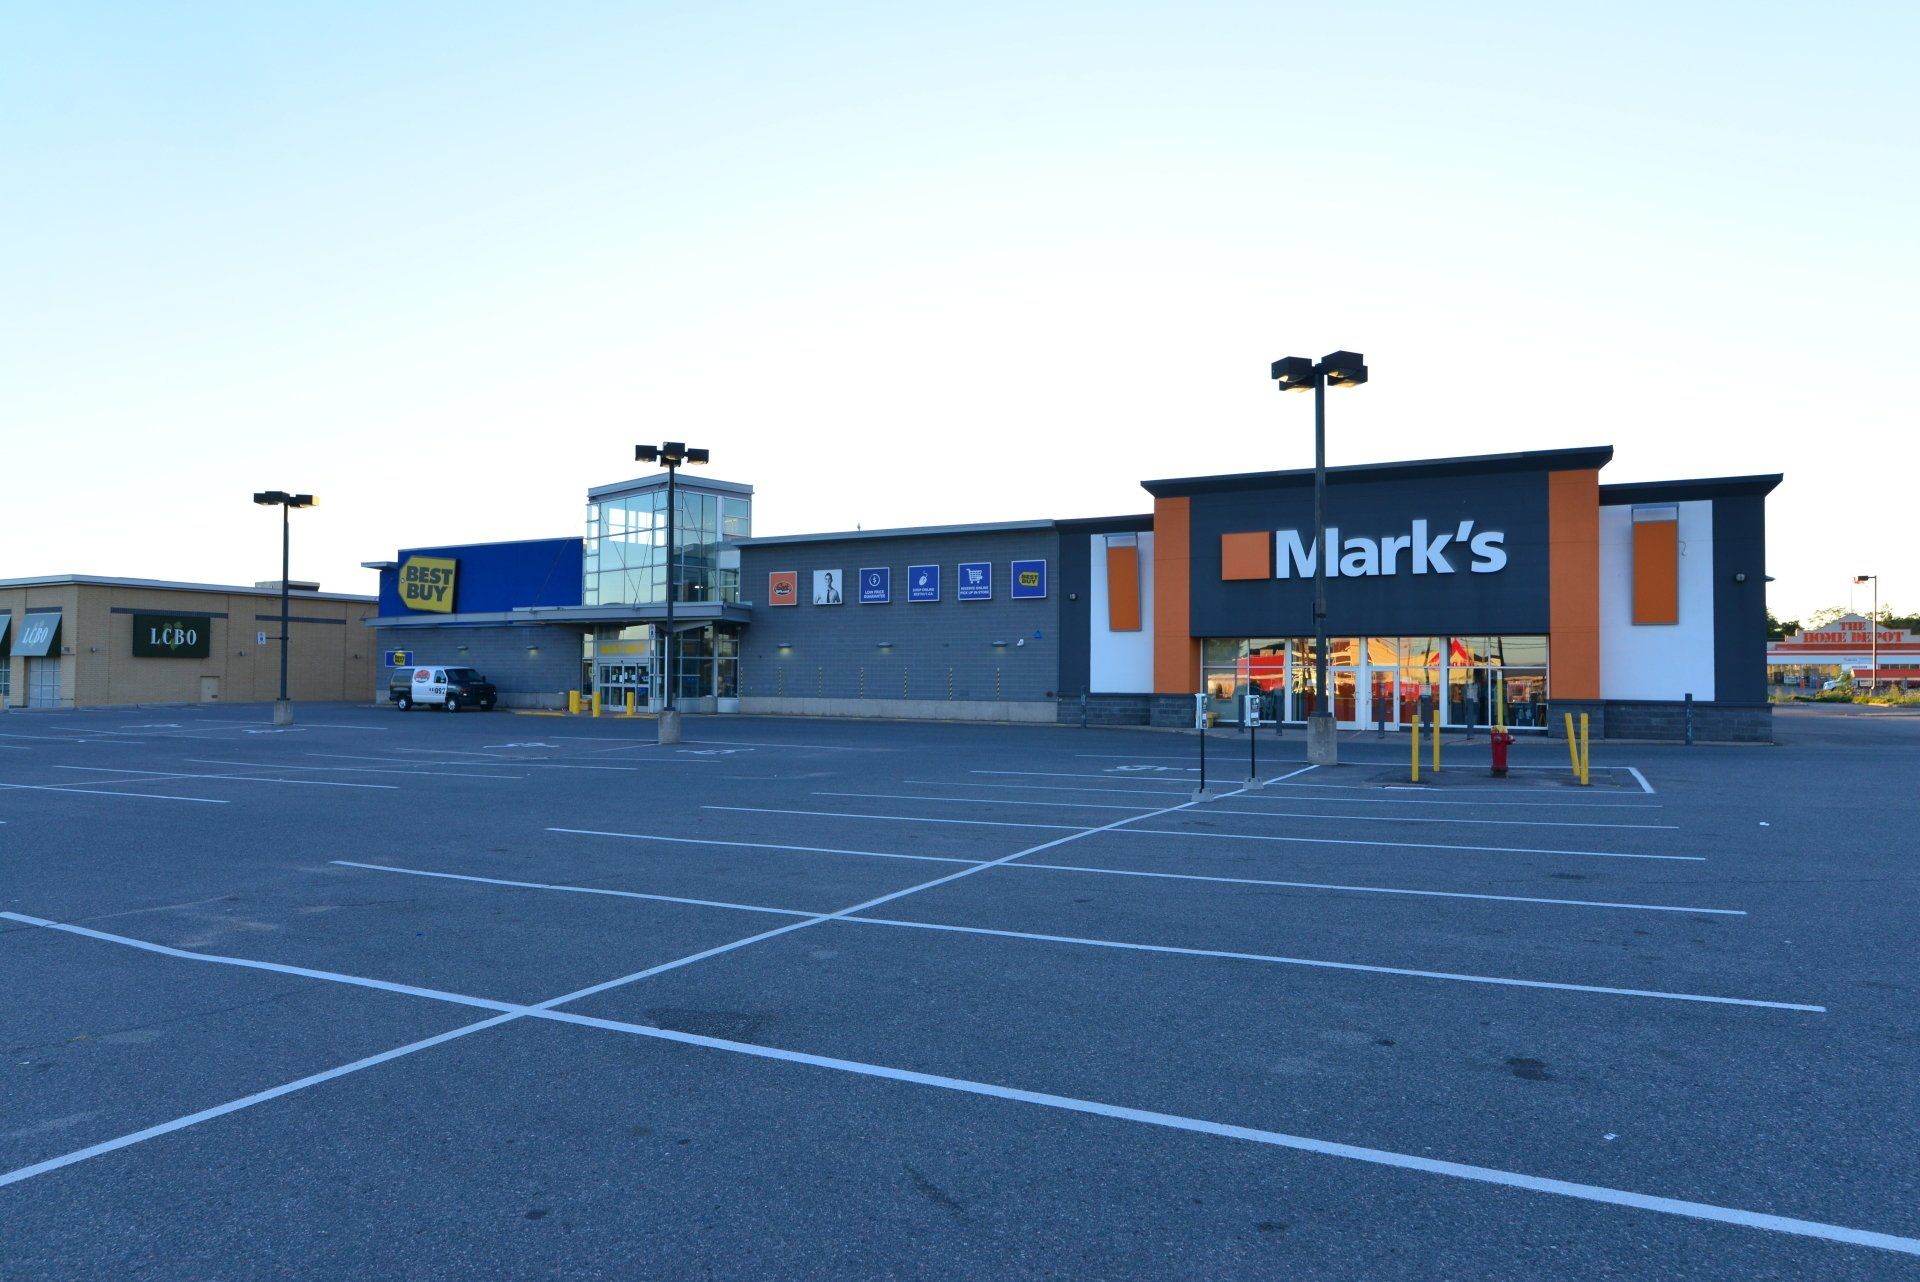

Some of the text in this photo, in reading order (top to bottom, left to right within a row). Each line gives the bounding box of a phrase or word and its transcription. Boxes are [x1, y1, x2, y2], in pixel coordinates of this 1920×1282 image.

[1275, 519, 1508, 579] Mark's
[406, 565, 453, 585] BEST
[407, 582, 448, 602] BUY
[1839, 621, 1866, 631] THE
[22, 627, 49, 644] LCBO
[150, 627, 197, 645] LCBO
[1803, 632, 1847, 643] HOME
